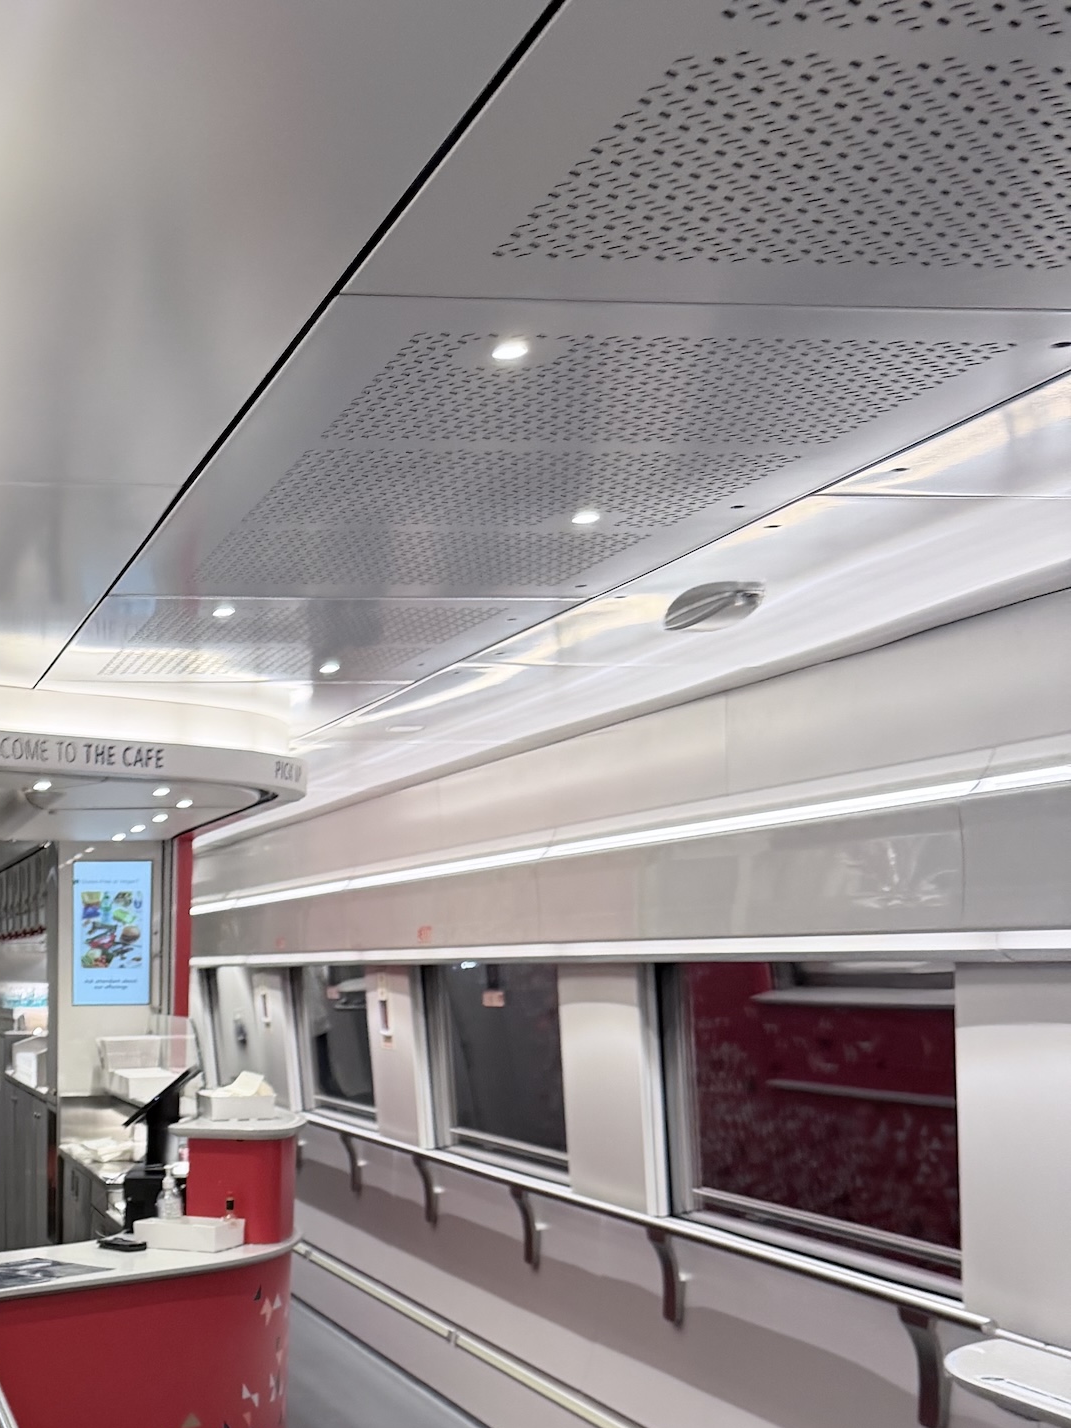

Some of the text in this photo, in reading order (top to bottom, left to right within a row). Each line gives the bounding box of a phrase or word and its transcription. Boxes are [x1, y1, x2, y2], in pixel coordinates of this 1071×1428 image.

[56, 741, 77, 764] TO
[82, 743, 116, 767] THE
[122, 746, 165, 769] CAFE
[274, 760, 293, 782] PICK
